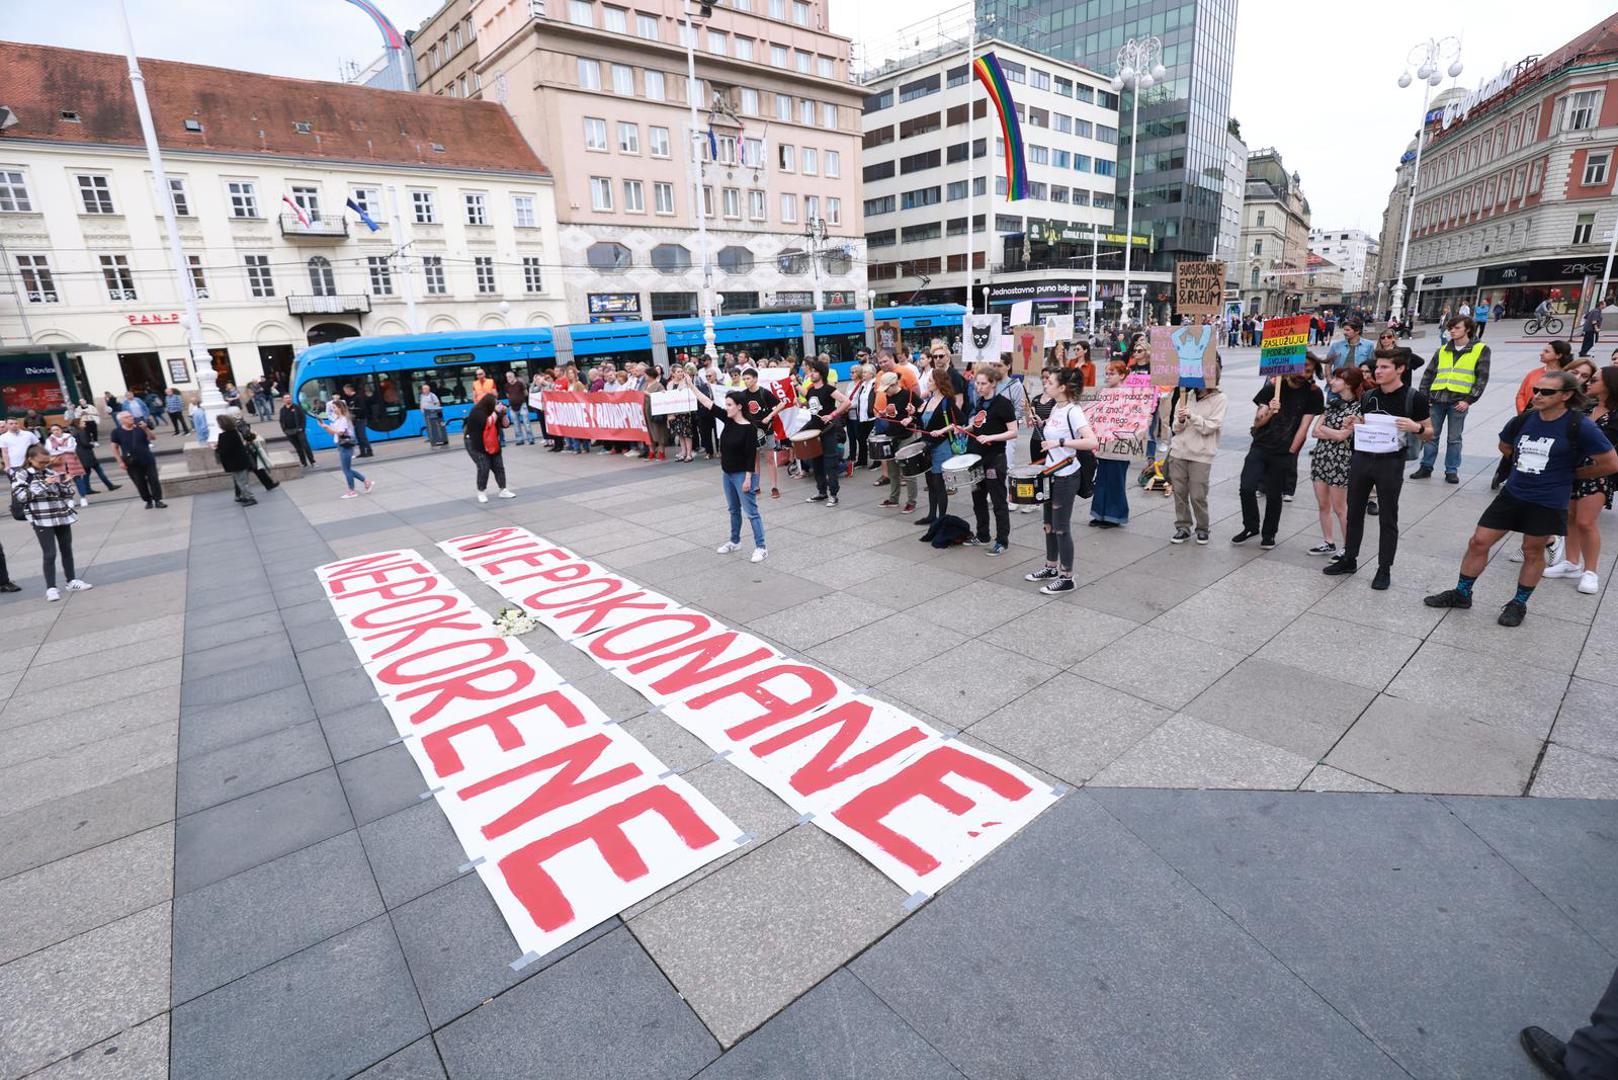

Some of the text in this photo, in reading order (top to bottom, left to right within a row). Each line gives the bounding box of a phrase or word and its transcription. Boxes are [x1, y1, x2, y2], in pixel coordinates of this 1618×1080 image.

[1561, 262, 1604, 274] ZAKS
[1180, 276, 1221, 291] EMPATIJA
[991, 286, 1035, 296] Jednostavno
[1179, 289, 1221, 306] & RAZUM
[1270, 328, 1295, 338] DJECA
[1263, 335, 1305, 348] ZASLUŽUJU
[1110, 415, 1129, 428] nego
[449, 528, 1034, 877] NIEPOKONANE
[325, 553, 720, 932] NEPOKORENE
